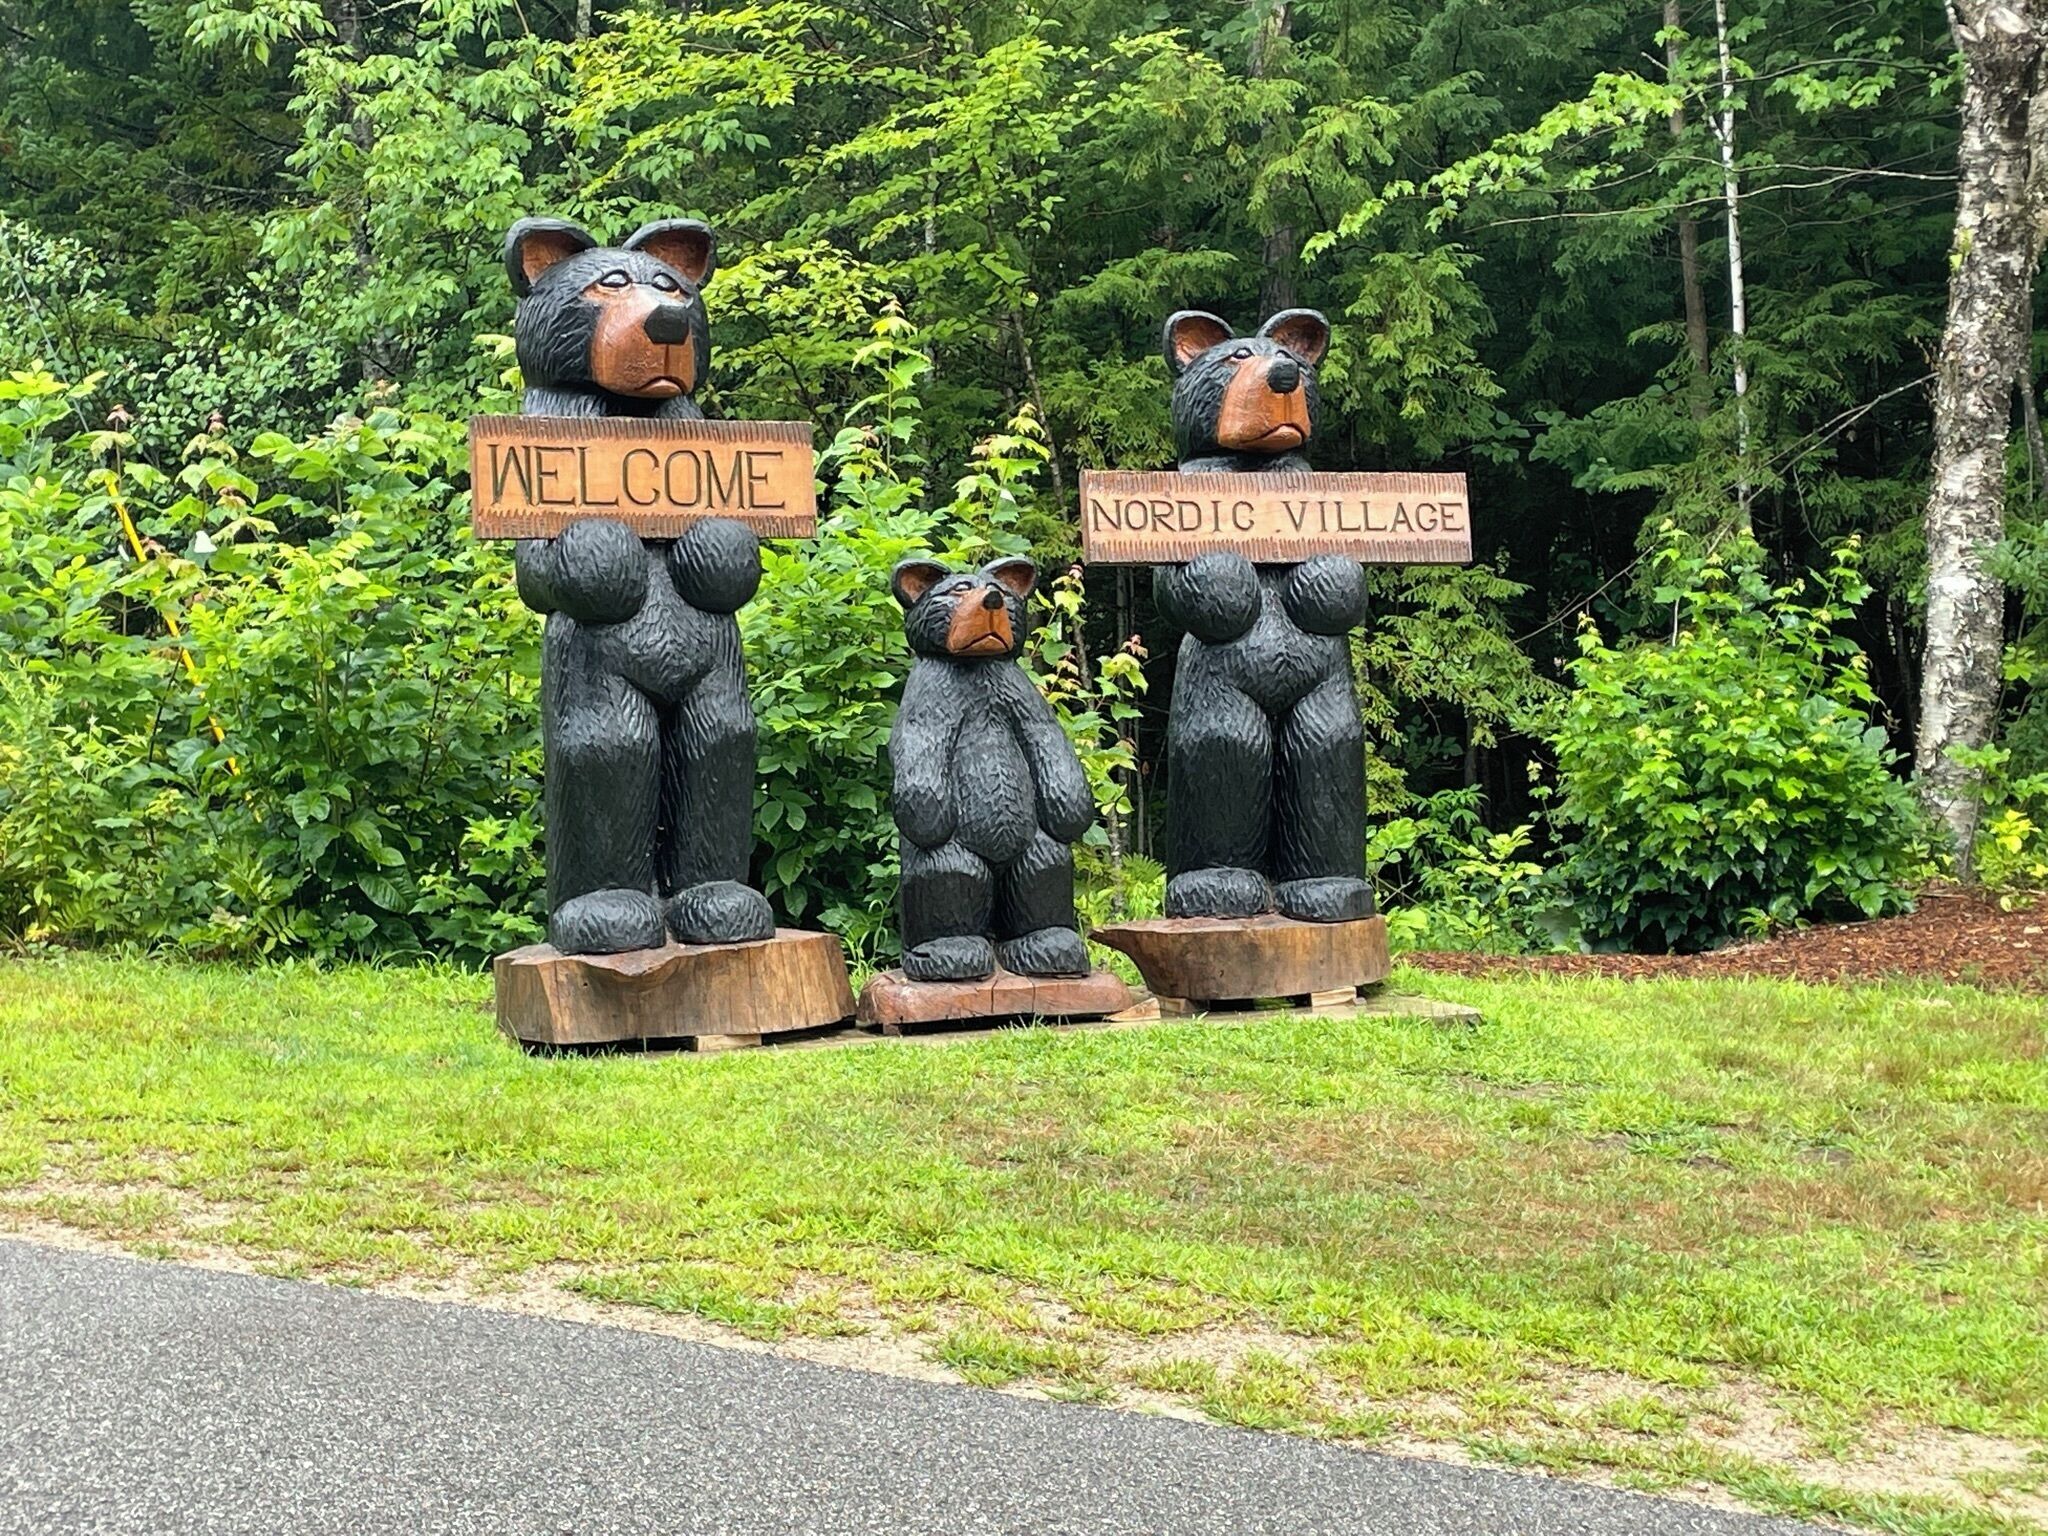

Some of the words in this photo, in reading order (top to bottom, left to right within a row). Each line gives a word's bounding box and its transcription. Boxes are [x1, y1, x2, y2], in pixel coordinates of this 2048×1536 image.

[487, 444, 785, 509] WELCOME
[1091, 498, 1255, 533] NORDIC
[1281, 500, 1464, 533] VILLAGE
